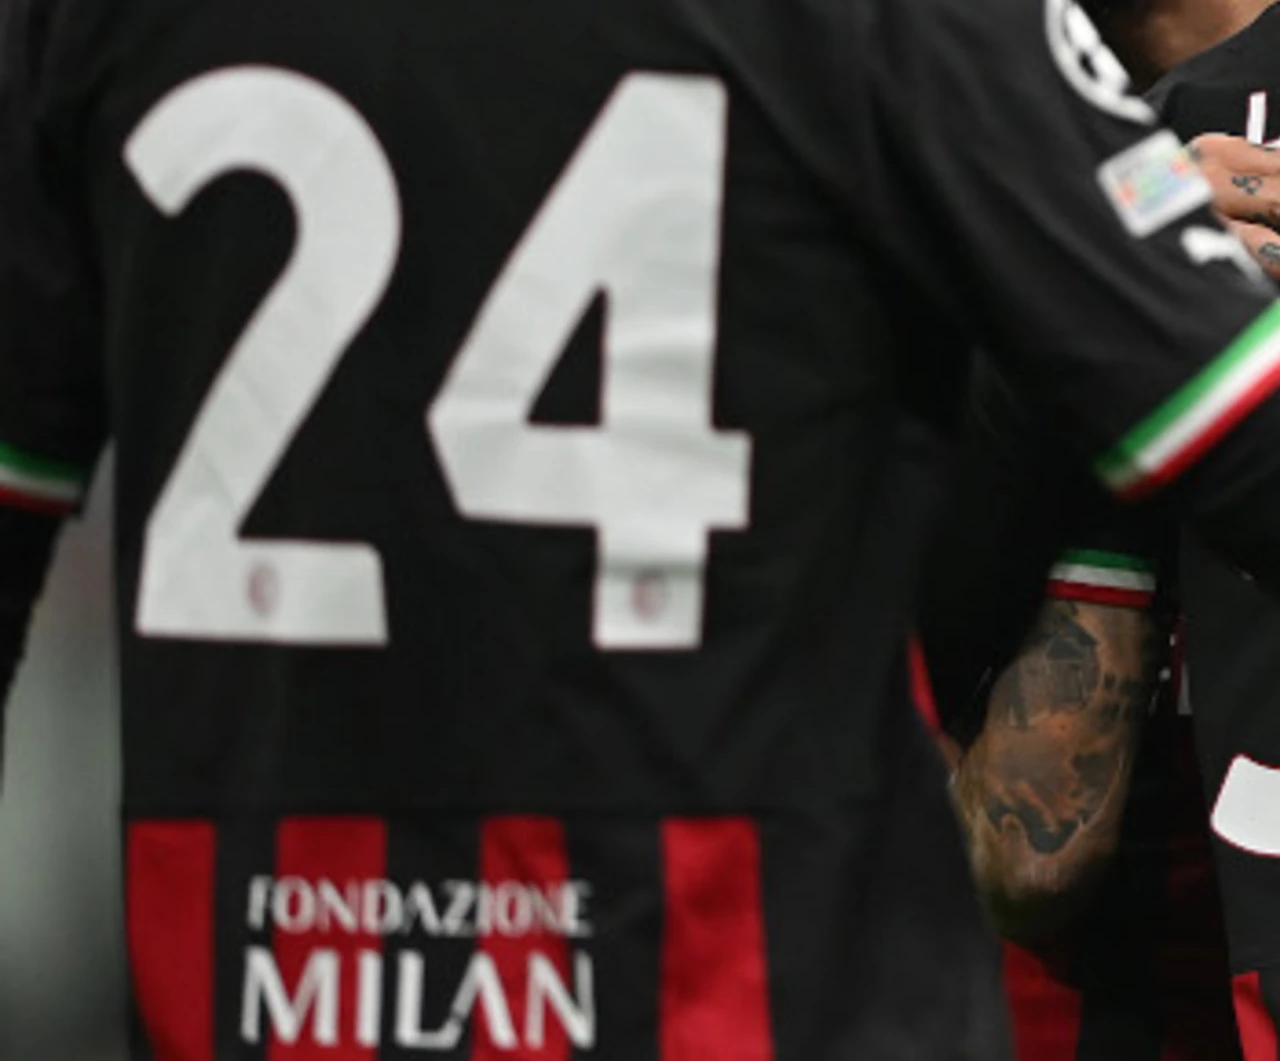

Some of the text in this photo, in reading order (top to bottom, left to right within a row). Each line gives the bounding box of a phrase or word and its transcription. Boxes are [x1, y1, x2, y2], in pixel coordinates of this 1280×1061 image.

[125, 66, 750, 649] 24
[247, 876, 591, 937] FONDAZIONE
[241, 946, 595, 1049] MILAN
